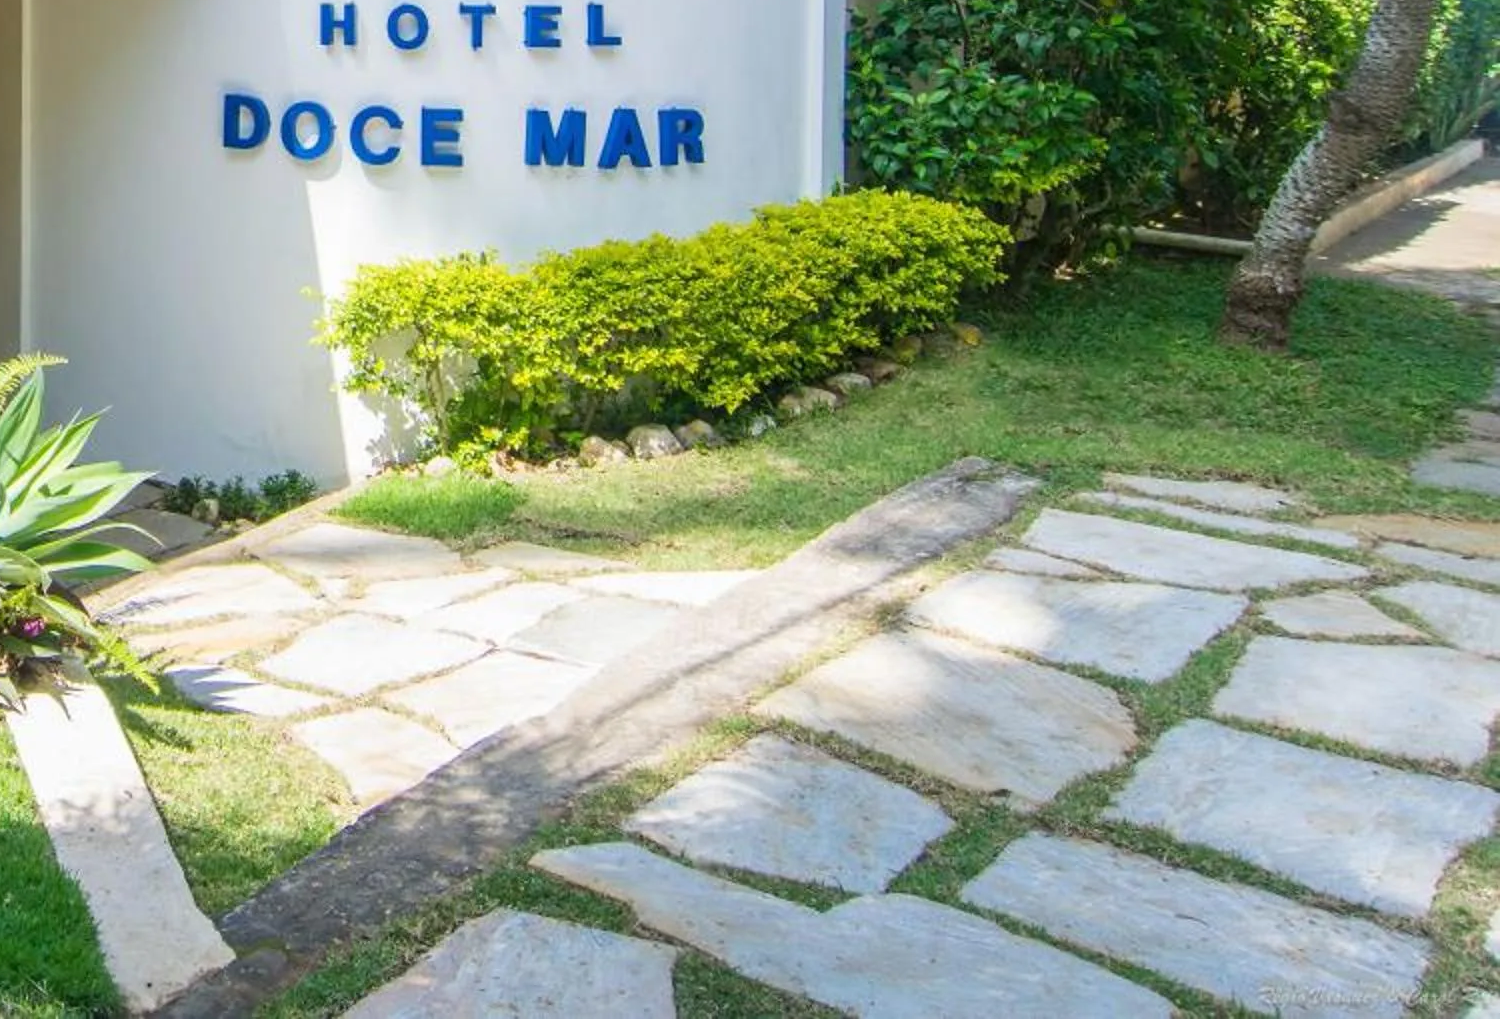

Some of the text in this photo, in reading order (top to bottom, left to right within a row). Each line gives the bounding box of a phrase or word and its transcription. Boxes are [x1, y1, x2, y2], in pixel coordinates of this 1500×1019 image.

[318, 2, 622, 50] HOTEL
[222, 93, 705, 169] DOCE MAR
